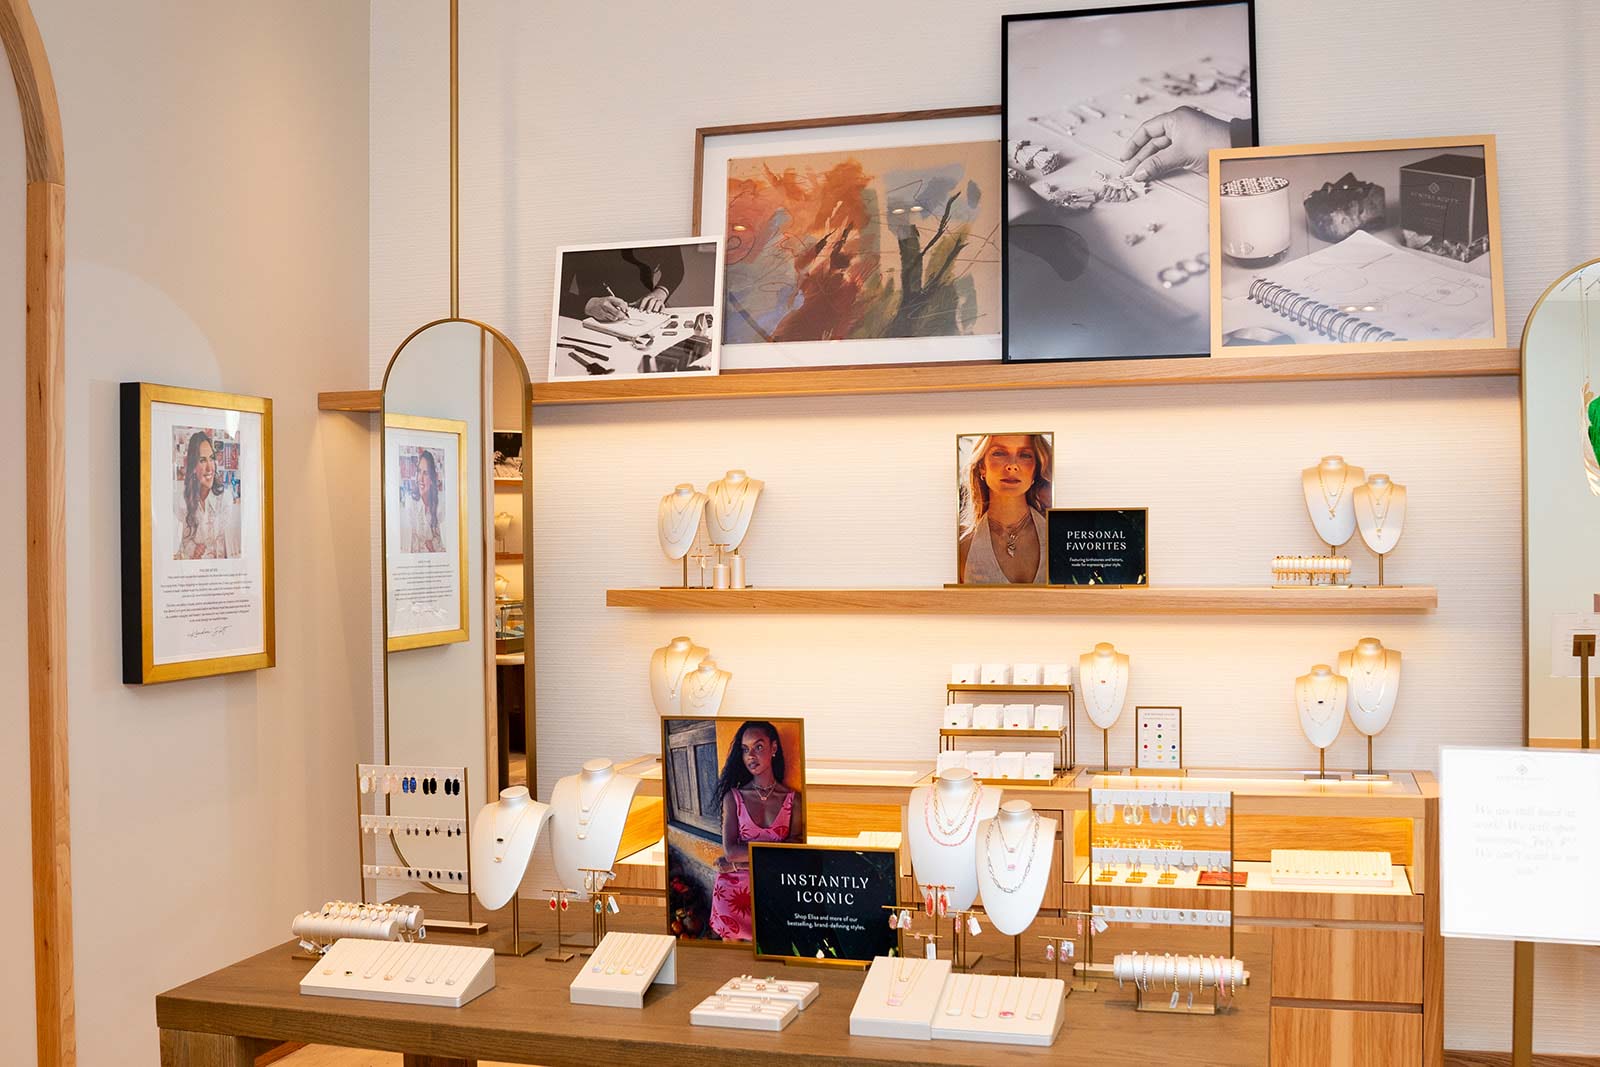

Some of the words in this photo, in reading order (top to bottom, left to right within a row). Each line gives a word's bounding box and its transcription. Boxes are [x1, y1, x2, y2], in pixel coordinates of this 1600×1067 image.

[1067, 530, 1126, 539] PERSONAL
[1066, 542, 1127, 551] FAVORITES
[781, 873, 869, 889] INSTANTLY
[797, 890, 854, 905] ICONIC
[794, 912, 807, 920] Shop
[787, 919, 813, 929] bestselling,
[814, 921, 850, 931] brand-defining
[850, 923, 866, 931] styles.
